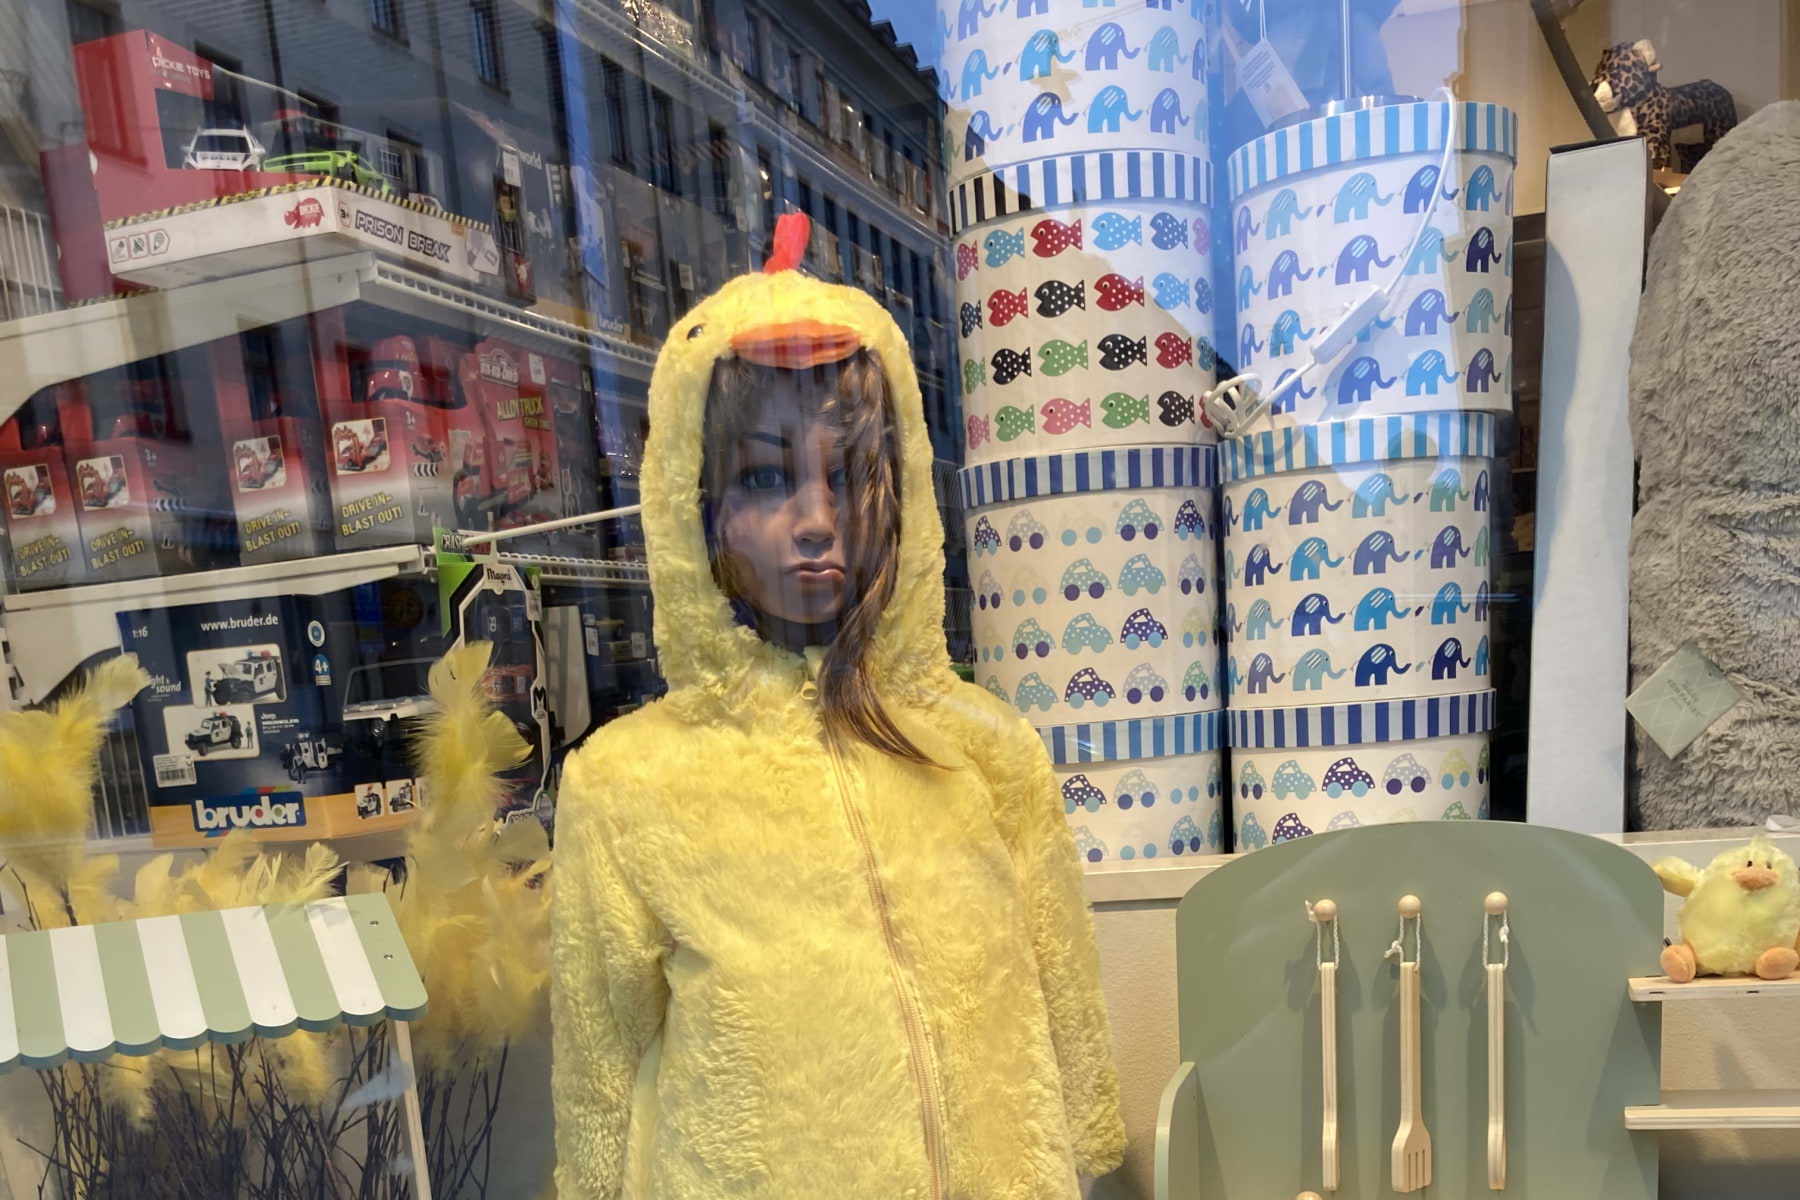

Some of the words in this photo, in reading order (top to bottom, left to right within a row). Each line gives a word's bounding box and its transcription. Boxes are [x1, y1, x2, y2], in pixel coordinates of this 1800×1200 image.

[186, 65, 211, 80] TOYS
[355, 210, 404, 246] PRISON
[408, 230, 452, 263] BREAK
[341, 498, 373, 518] DRIVE
[374, 492, 392, 506] IN-
[245, 513, 272, 534] DRIVE
[273, 508, 290, 521] IN-
[341, 515, 375, 537] BLAST
[378, 505, 403, 524] OUT!
[18, 539, 46, 559] DRIVE
[91, 531, 116, 552] DRIVE
[117, 527, 134, 541] IN-
[246, 531, 275, 552] BLAST
[278, 522, 301, 539] OUT!
[20, 557, 48, 577] BLAST
[91, 549, 122, 569] BLAST
[122, 540, 145, 557] OUT!
[132, 626, 148, 639] 1:16
[200, 613, 279, 632] www.bruder.de
[315, 659, 329, 675] 4+
[156, 680, 182, 693] sound
[195, 796, 300, 830] bruder
